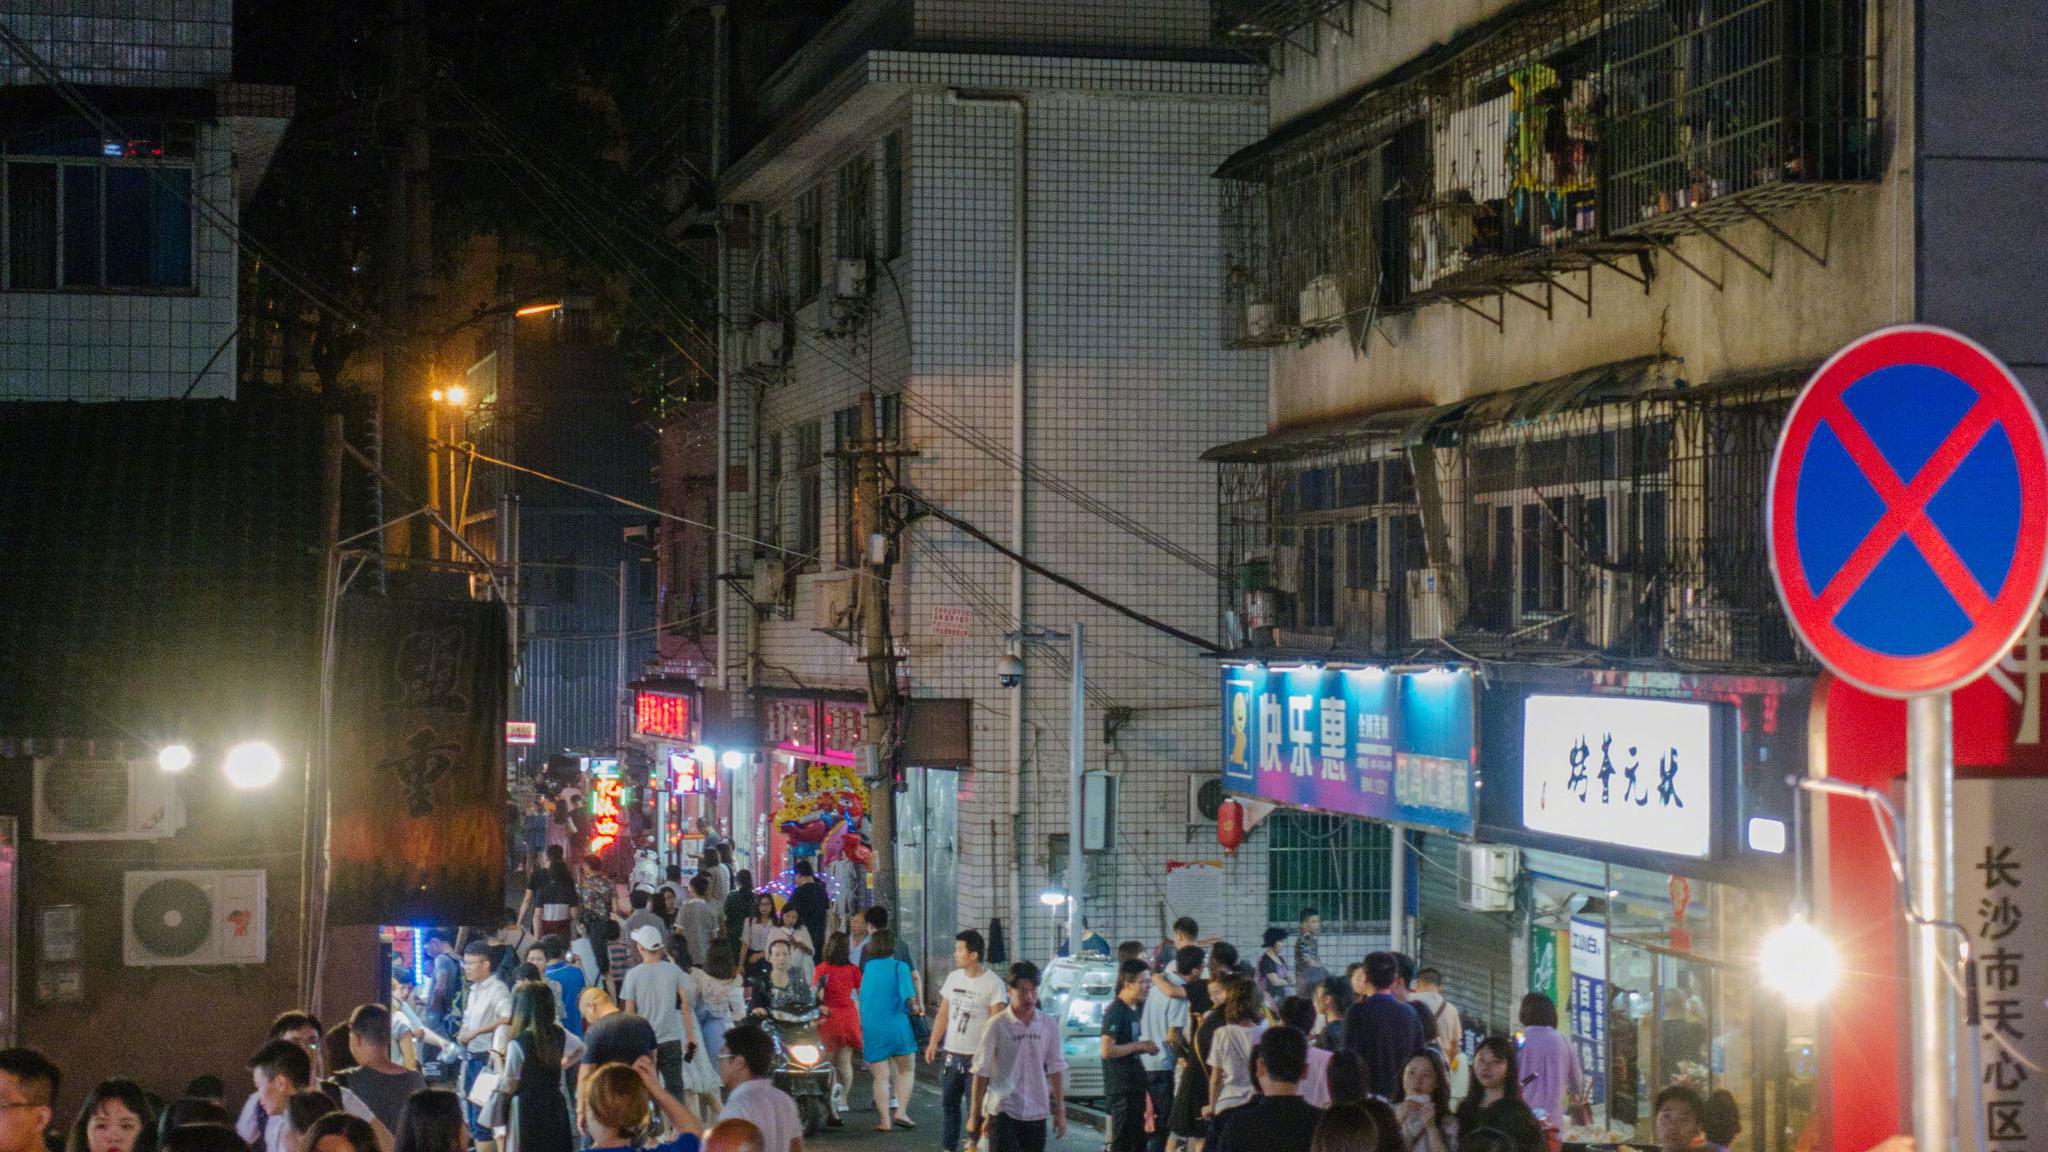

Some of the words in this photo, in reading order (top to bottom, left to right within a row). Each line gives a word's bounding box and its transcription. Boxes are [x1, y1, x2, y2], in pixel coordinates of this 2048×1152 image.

[1259, 693, 1346, 781] 快乐惠
[1976, 846, 2027, 1141] 长沙市天心区
